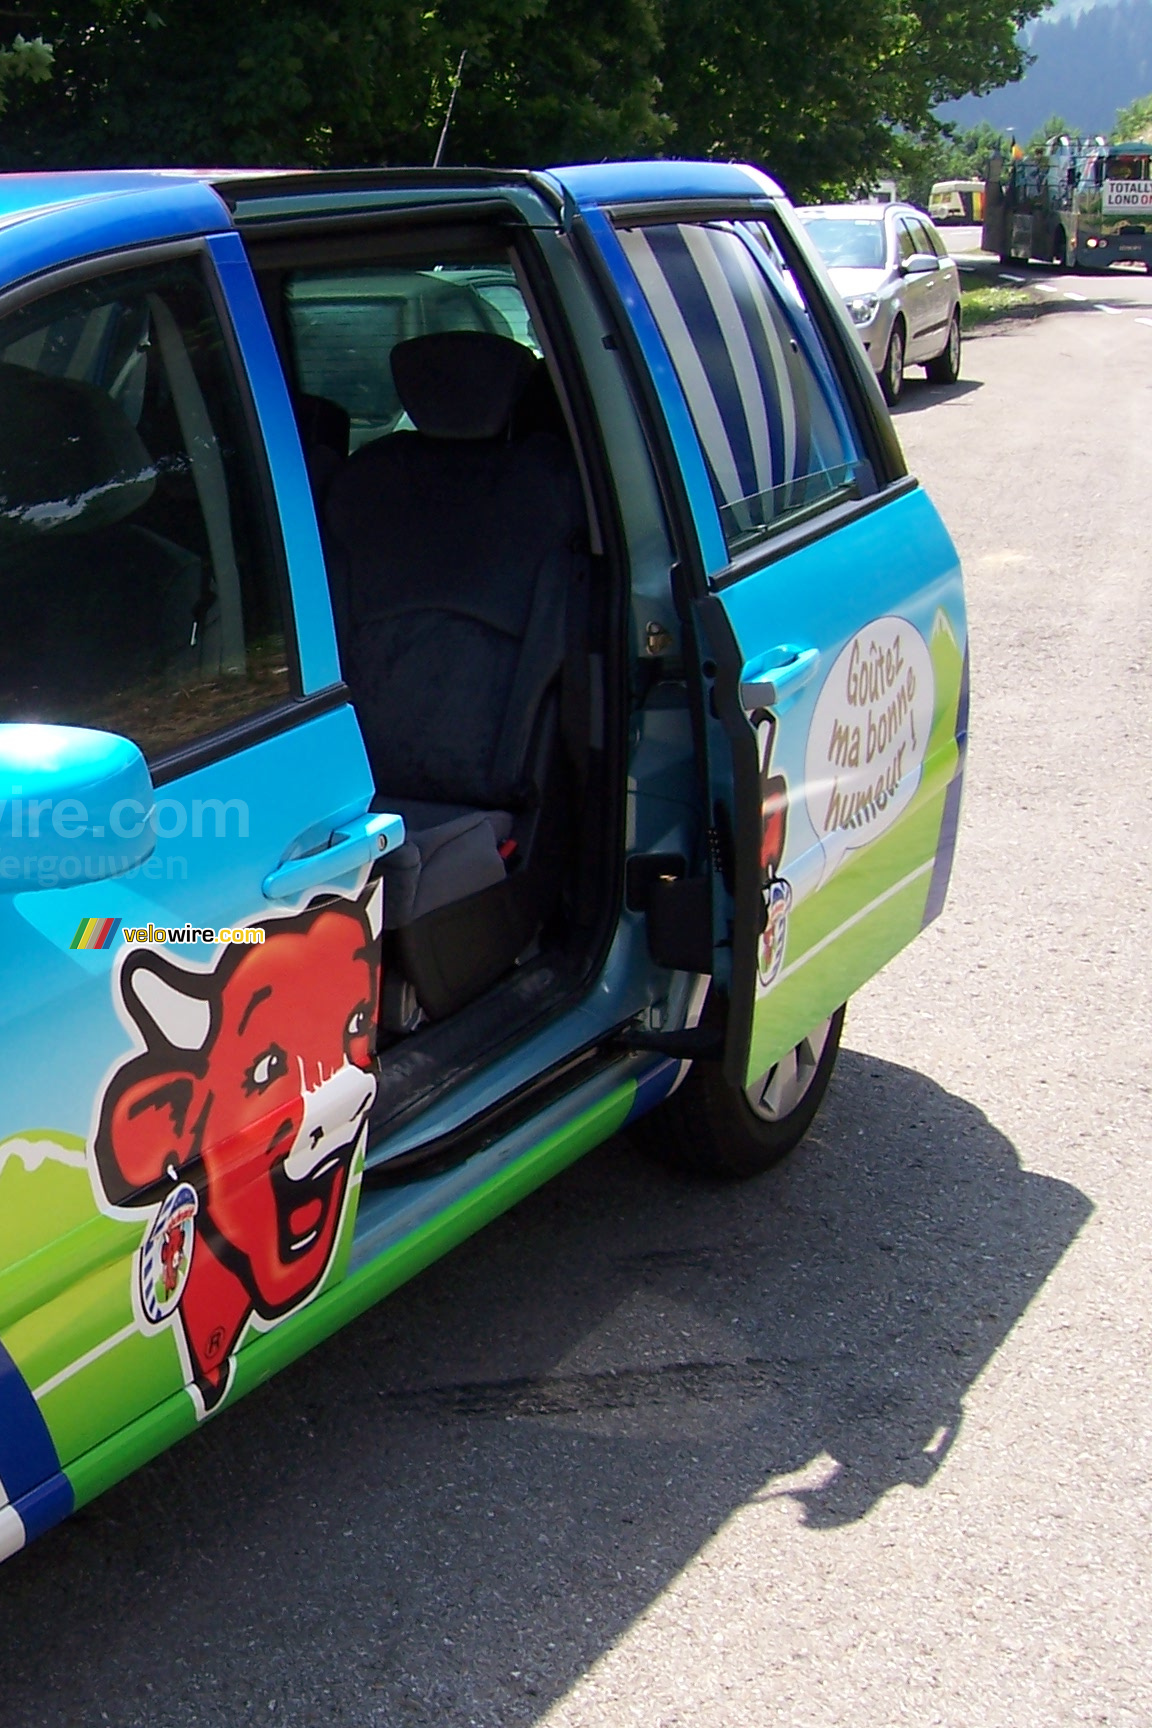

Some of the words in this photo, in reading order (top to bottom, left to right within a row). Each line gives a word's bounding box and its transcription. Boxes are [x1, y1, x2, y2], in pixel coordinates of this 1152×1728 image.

[827, 718, 860, 769] ma
[865, 666, 917, 765] bonne
[846, 635, 905, 707] Goûtez
[823, 739, 907, 833] humeur
